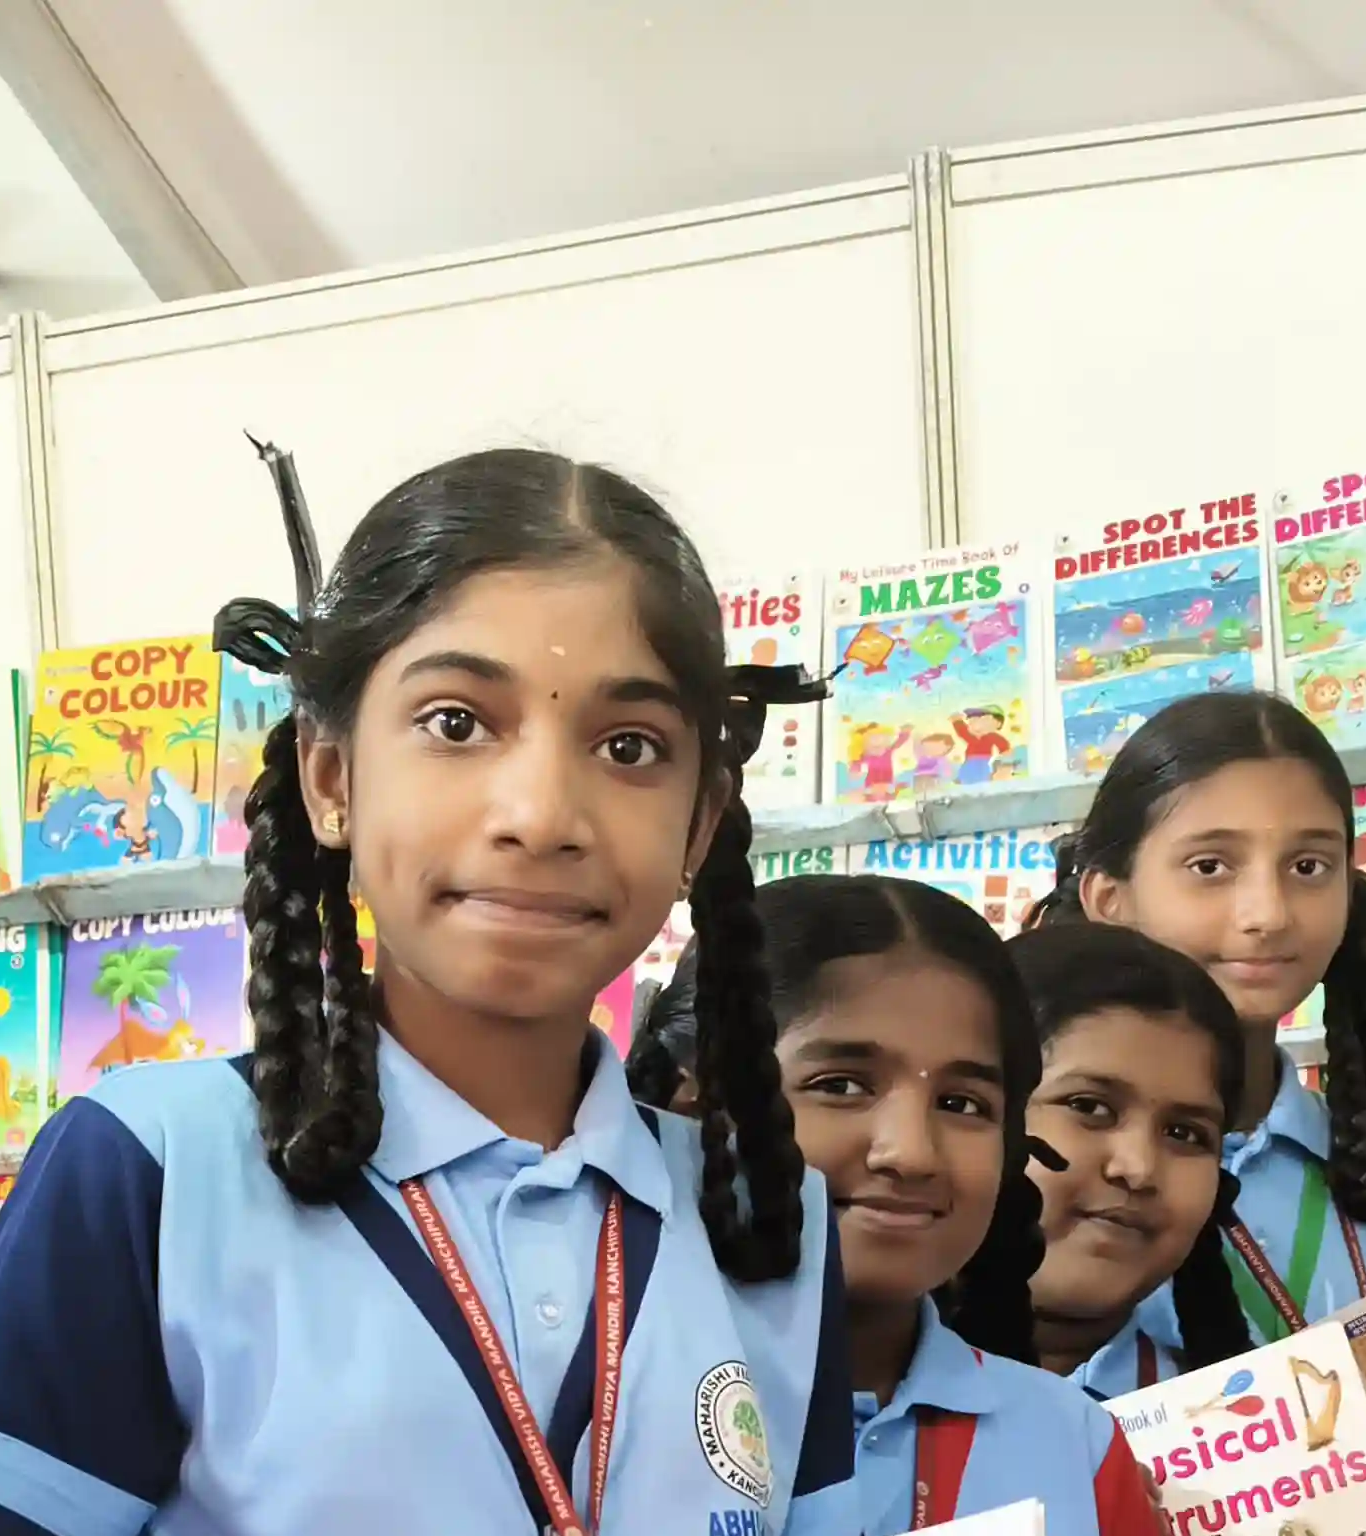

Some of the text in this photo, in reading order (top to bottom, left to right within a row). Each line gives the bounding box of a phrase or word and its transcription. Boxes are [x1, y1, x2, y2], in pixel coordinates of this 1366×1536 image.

[1102, 492, 1258, 545] SPOT THE
[839, 569, 859, 584] My
[862, 562, 916, 581] Leisure
[962, 547, 996, 565] Book
[1053, 518, 1260, 581] DIFFERENCES
[859, 564, 1002, 616] MAZES
[91, 643, 194, 681] COPY
[59, 678, 209, 719] COLOUR
[498, 1367, 526, 1421] VIDYA
[601, 1368, 619, 1423] VIDYA
[701, 1367, 732, 1458] MAHARISHI
[1155, 1401, 1168, 1426] of
[520, 1421, 571, 1521] MAHARISHI
